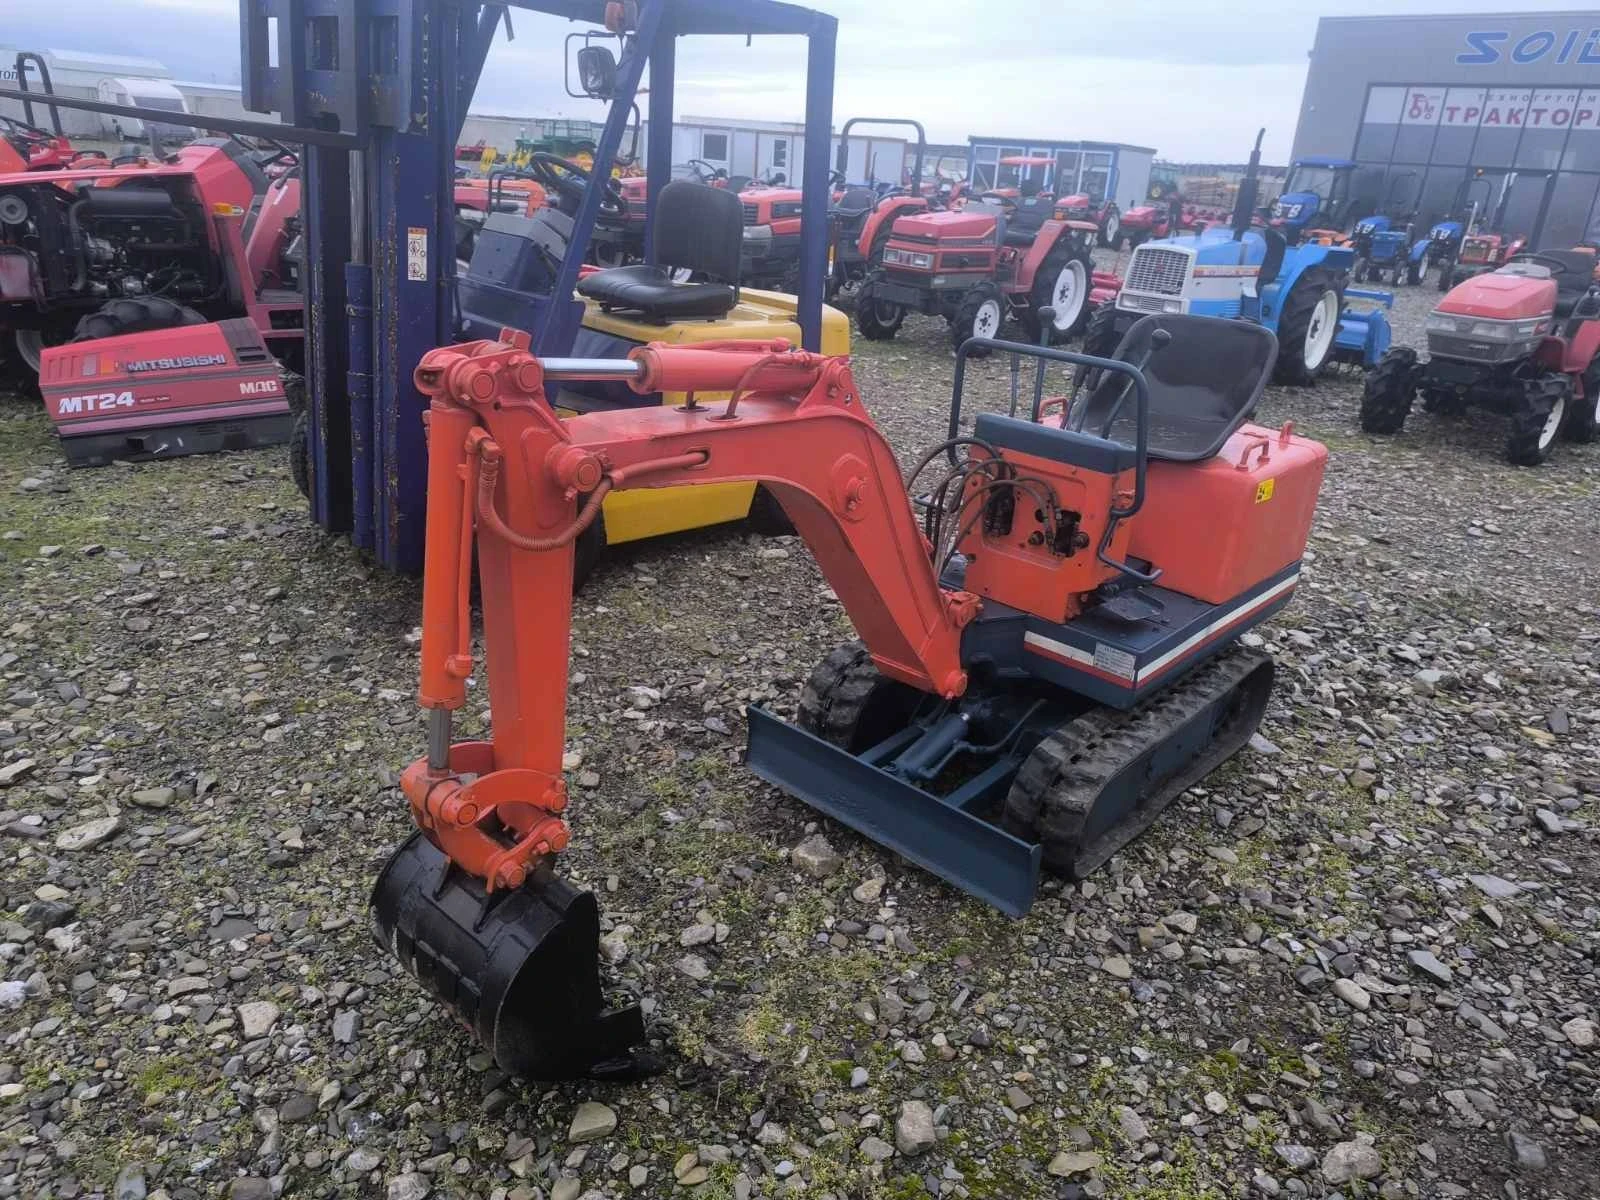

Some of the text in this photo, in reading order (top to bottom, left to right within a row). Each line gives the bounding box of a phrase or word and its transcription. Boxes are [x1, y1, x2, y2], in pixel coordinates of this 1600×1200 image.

[1446, 106, 1600, 127] ТРАКТОР
[127, 354, 226, 373] MITSUBISHI
[58, 391, 136, 414] MT24
